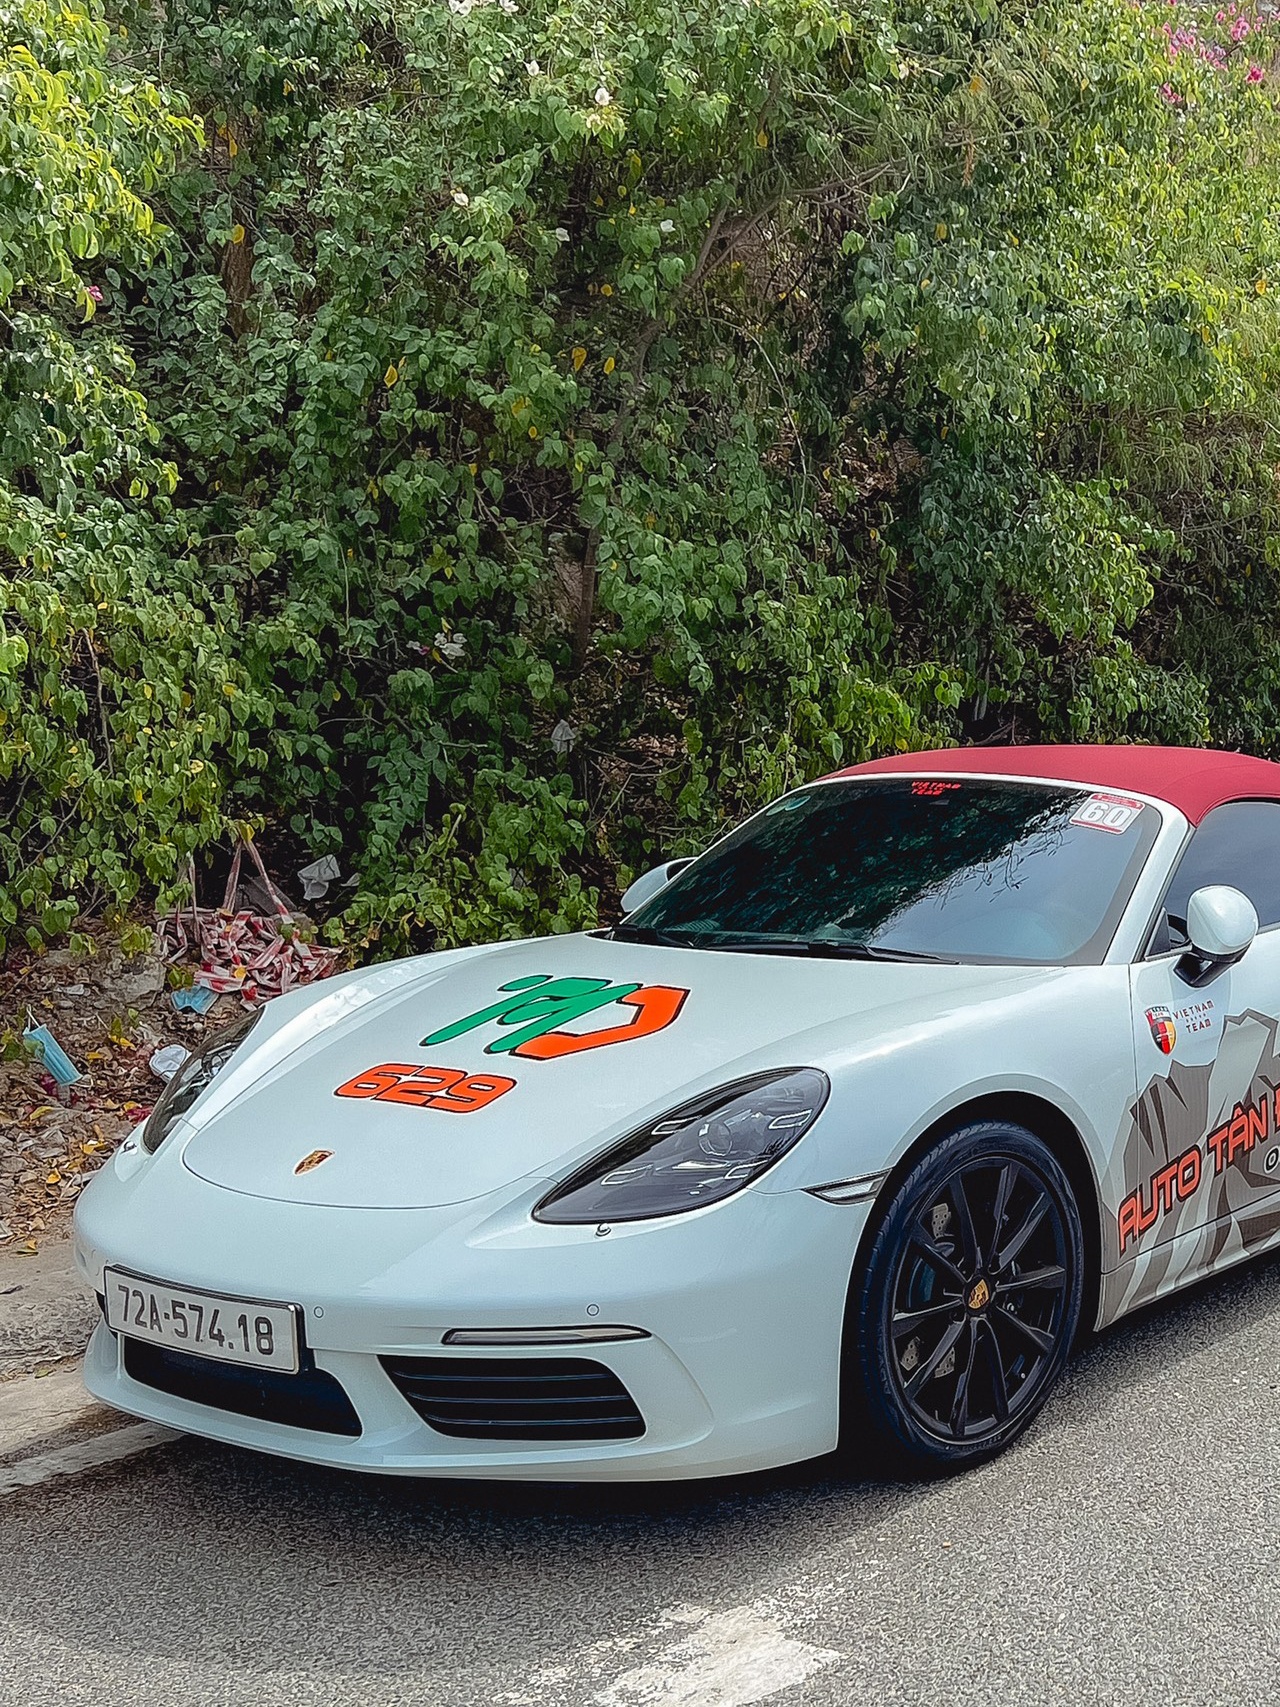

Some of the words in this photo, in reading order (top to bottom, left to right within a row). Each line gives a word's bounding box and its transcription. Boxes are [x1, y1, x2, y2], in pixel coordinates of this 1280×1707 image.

[1080, 801, 1132, 827] 60
[1172, 1000, 1214, 1019] VIETNAM
[1186, 1018, 1212, 1033] TEAM
[333, 1063, 517, 1114] 629
[1118, 1145, 1202, 1258] AUTO
[1207, 1100, 1268, 1177] TÂN
[118, 1284, 275, 1355] 72A-574.18
